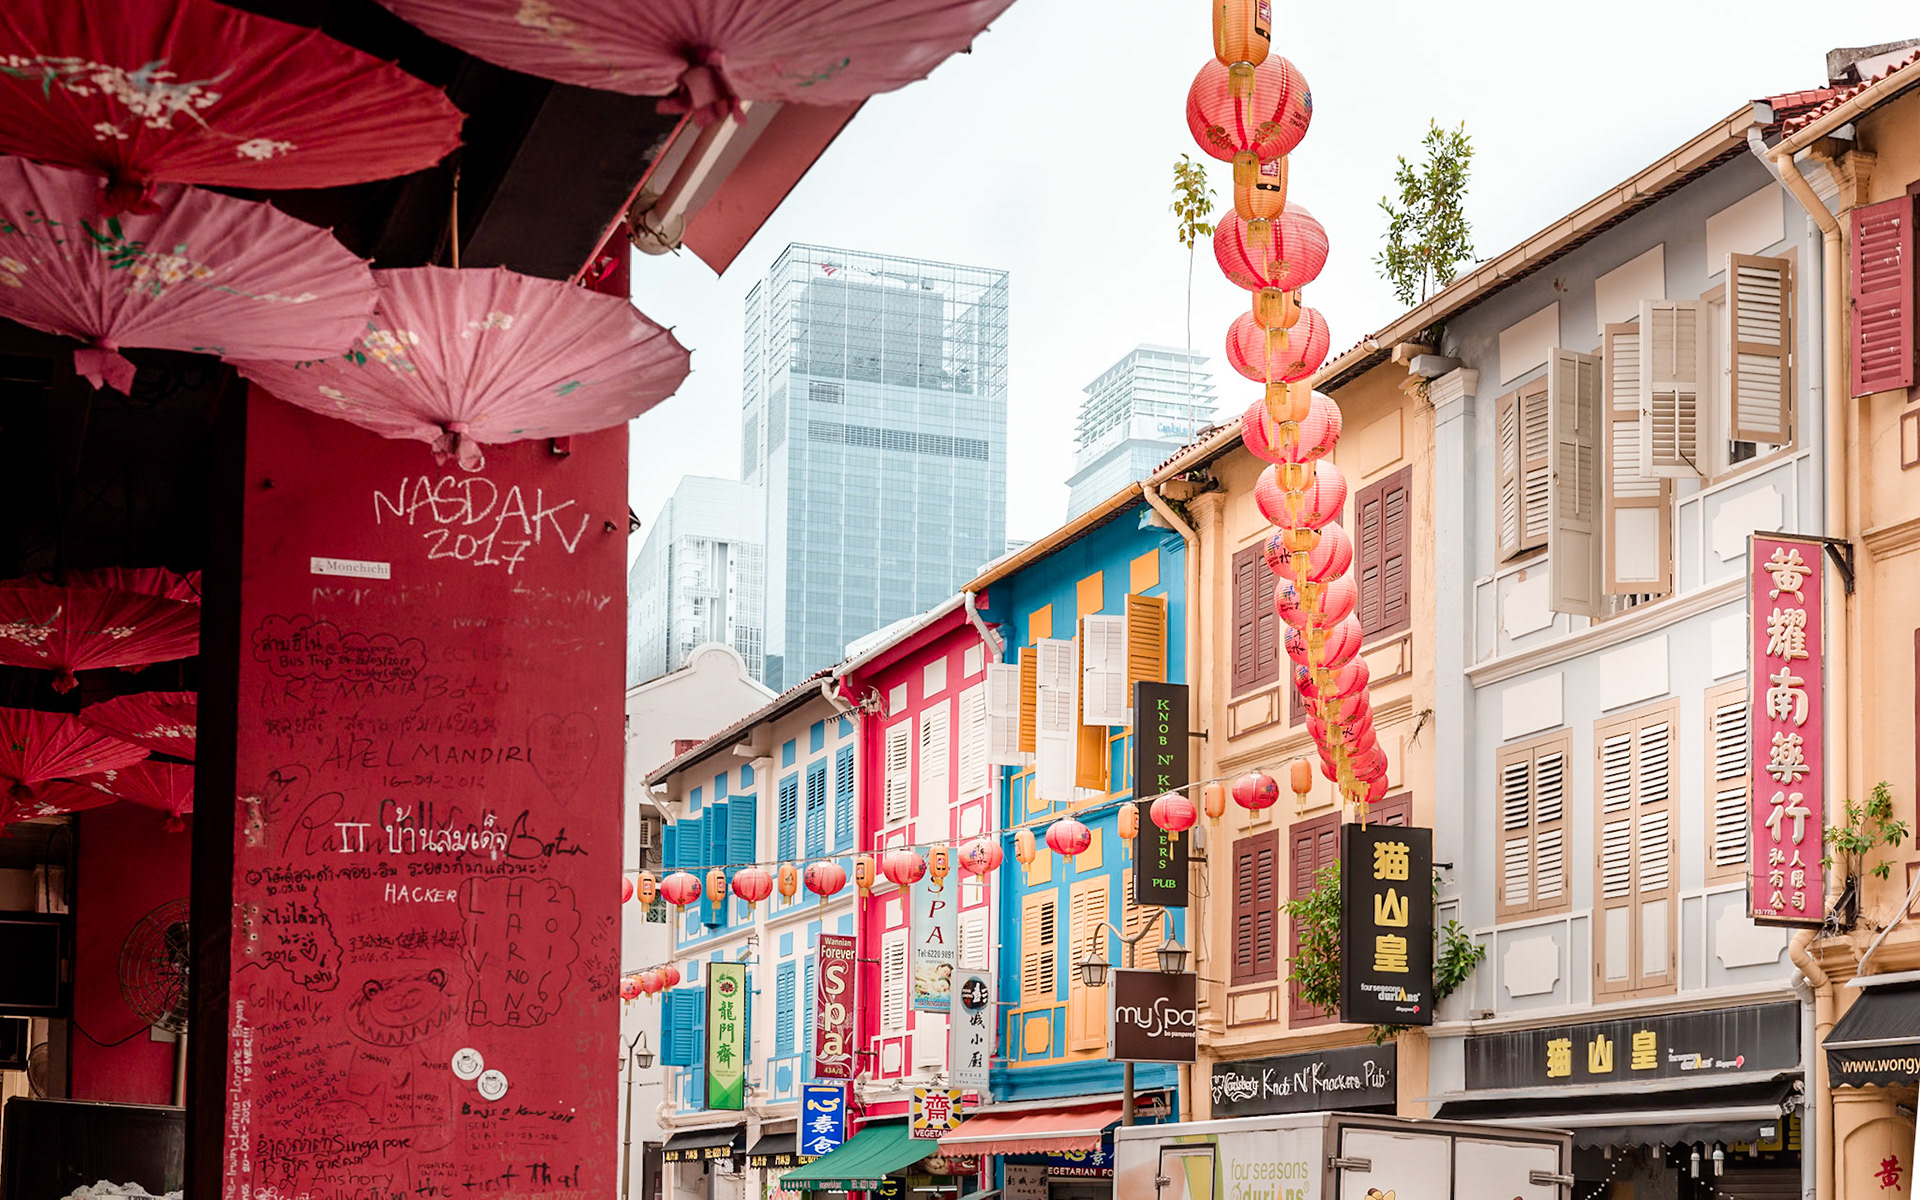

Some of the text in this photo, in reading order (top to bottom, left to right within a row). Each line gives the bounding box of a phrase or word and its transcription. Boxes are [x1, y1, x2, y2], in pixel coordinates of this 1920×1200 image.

[424, 529, 531, 574] 2017
[326, 560, 388, 574] Monchichi
[279, 655, 305, 668] Bus
[308, 654, 333, 671] Trip
[1157, 699, 1170, 746] KNOB
[411, 743, 532, 764] MANDIRI
[1152, 878, 1176, 888] PUB
[385, 883, 457, 903] HACKER
[824, 938, 852, 947] Wannian
[262, 949, 297, 962] 2016
[821, 945, 855, 960] Forever
[304, 970, 333, 984] Ashi
[824, 965, 846, 1056] Spa
[1546, 1029, 1659, 1078] 猫山皇
[1263, 1068, 1290, 1099] Knob
[1363, 1060, 1387, 1088] Pub
[1047, 1166, 1115, 1177] EGETARIAN FO
[1231, 1158, 1309, 1180] four seasons
